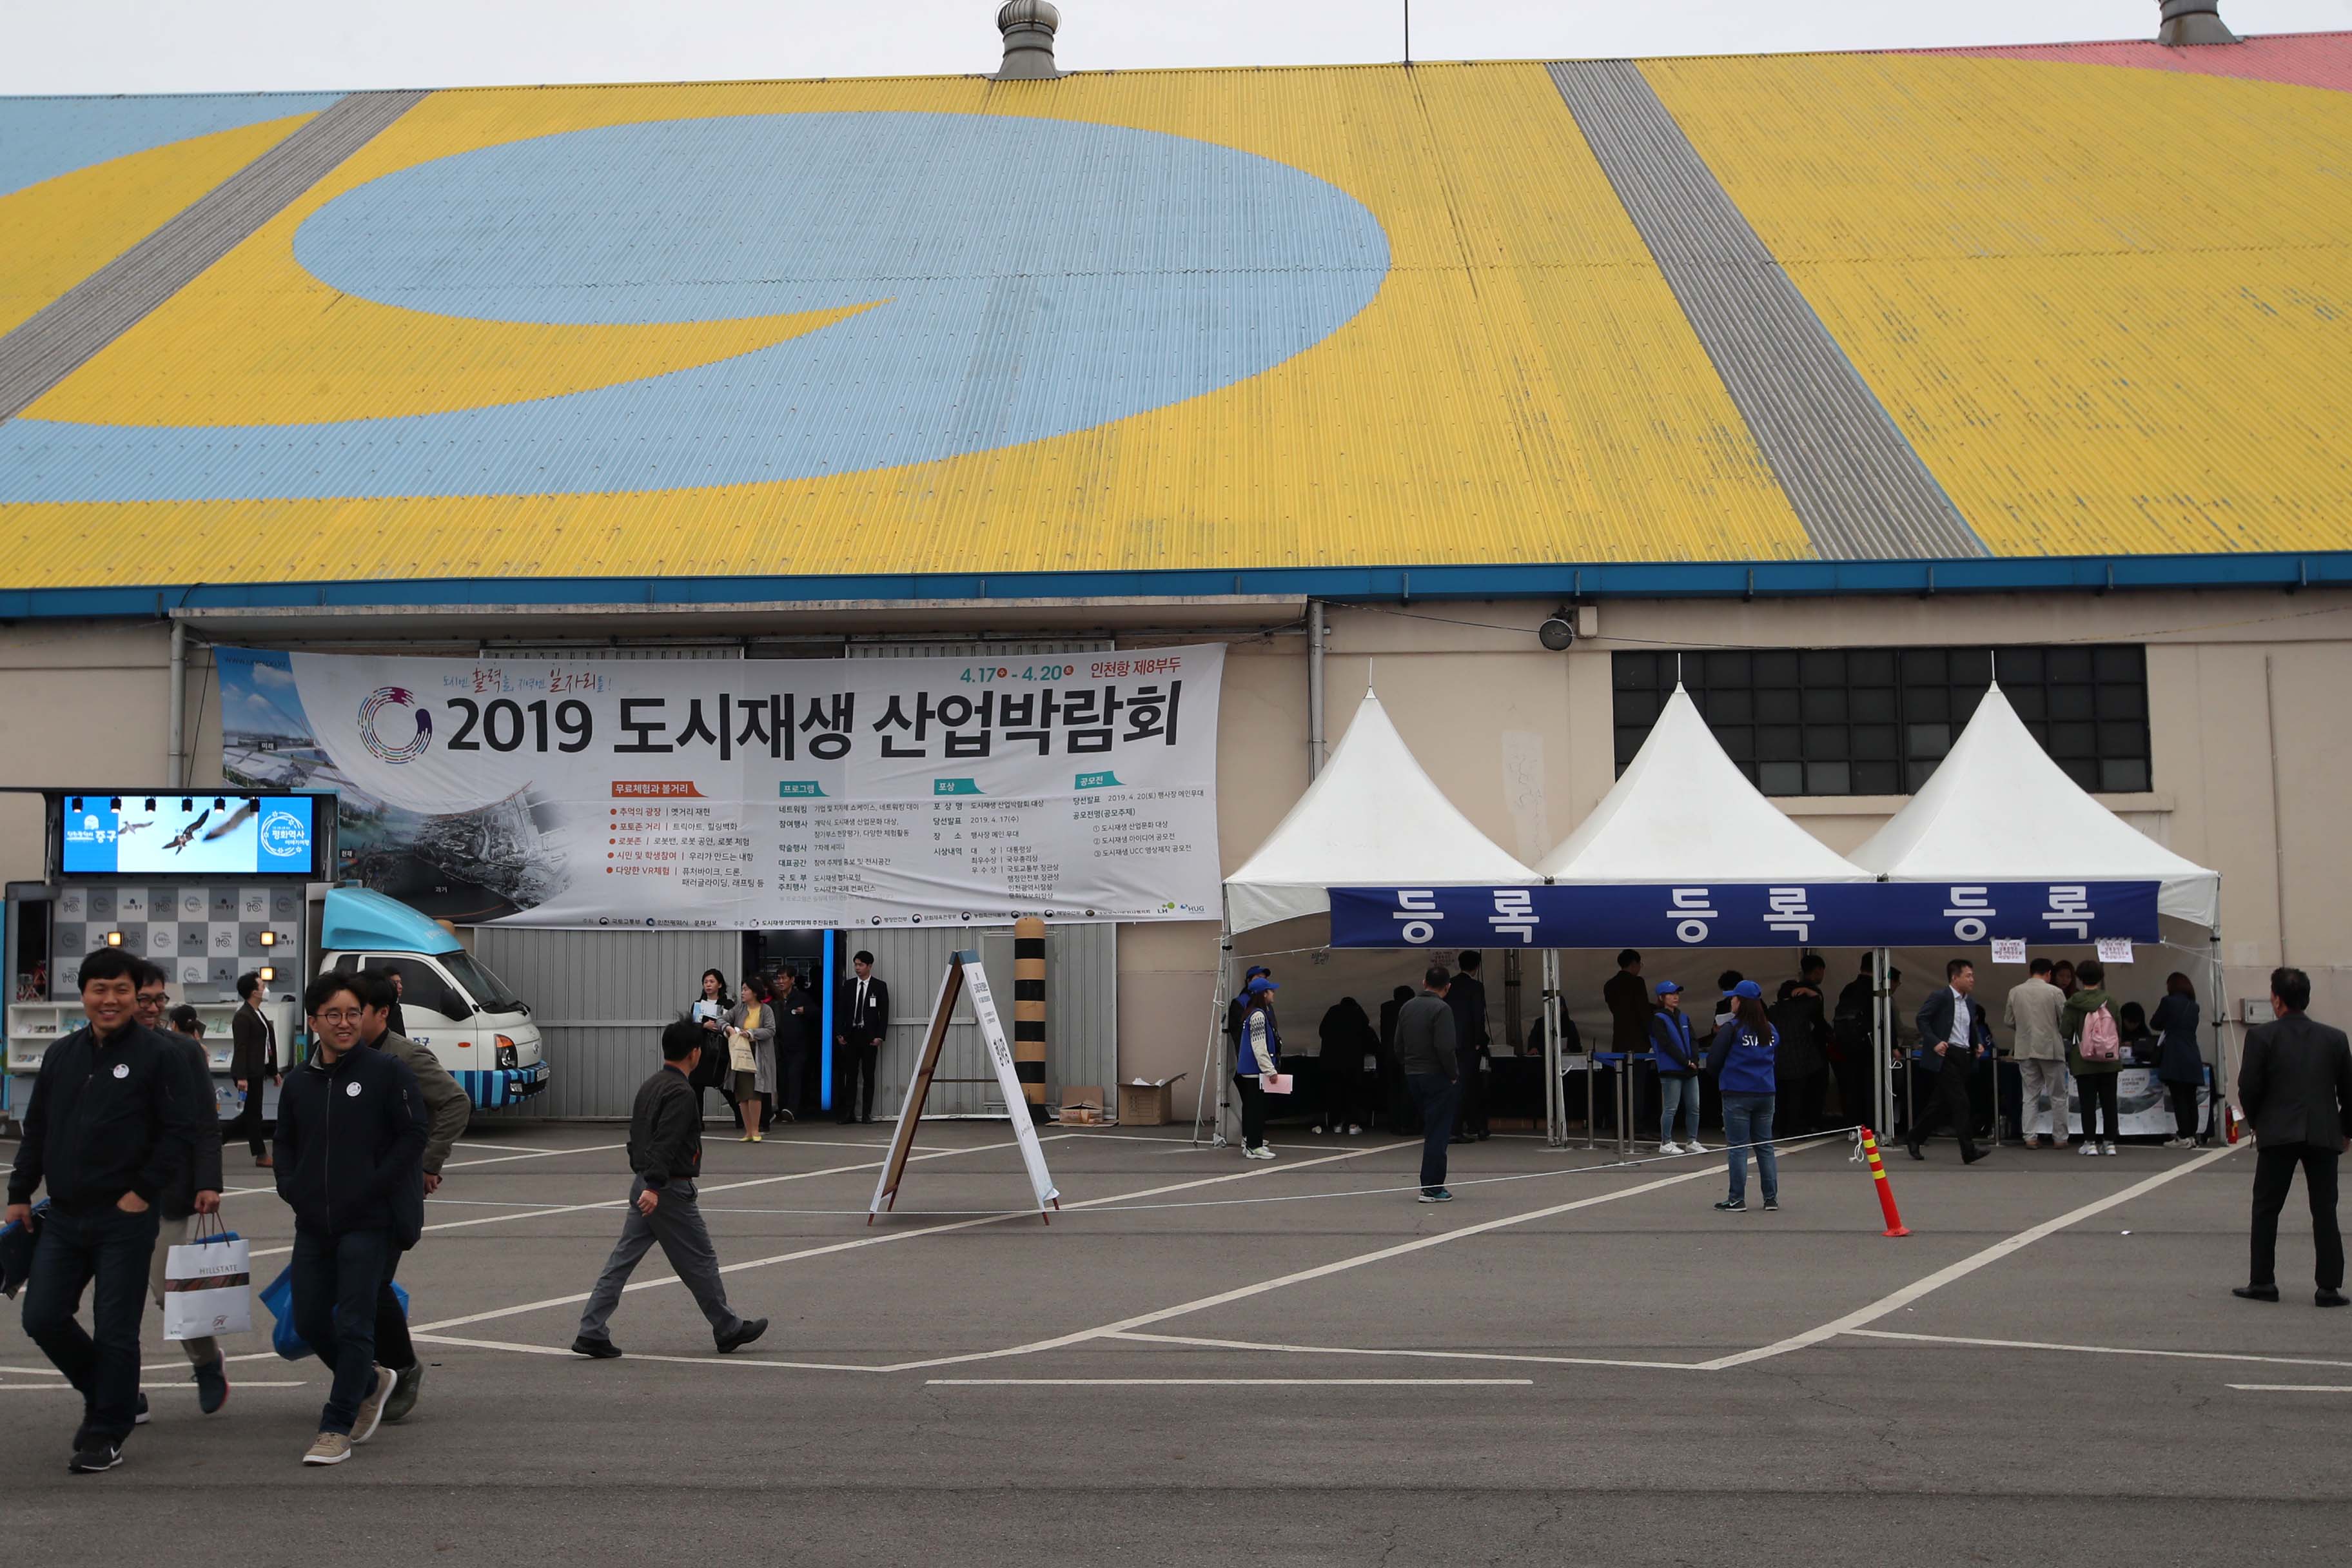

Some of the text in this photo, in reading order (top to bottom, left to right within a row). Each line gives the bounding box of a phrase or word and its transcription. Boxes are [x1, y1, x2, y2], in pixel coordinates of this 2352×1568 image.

[1090, 656, 1182, 679] 인천항 제8부두
[444, 676, 469, 687] 도시엔
[447, 680, 1182, 761] 2019 도시재생 산업박람회
[1080, 775, 1104, 787] 공모전
[615, 783, 689, 794] 무료체험과 볼거리
[783, 784, 815, 794] 프로그램
[938, 782, 955, 791] 포상
[1073, 796, 1101, 806] 당선발표
[1157, 790, 1177, 799] 행사장
[1178, 789, 1204, 798] 메인무대
[814, 805, 827, 813] 기업
[850, 803, 877, 812] 쇼케이스,
[970, 801, 996, 810] 도시재생
[997, 800, 1030, 808] 산업박람회
[620, 807, 710, 817] 추억의 광장 옛거리 재현
[1072, 808, 1136, 819] 공모전명(공모주제)
[779, 820, 808, 828] 참여행사
[857, 818, 882, 826] 산업문화
[884, 818, 899, 826] 대상,
[933, 817, 962, 825] 당선발표
[619, 823, 738, 832] 포토존 거리 트릭아트, 힐링벽화
[1101, 823, 1127, 832] 도시재생
[1129, 822, 1154, 830] 산업문화
[95, 830, 117, 843] 중구
[272, 830, 304, 839] 평화역사
[618, 838, 642, 846] 로봇존
[680, 838, 696, 846] 로봇
[698, 837, 716, 847] 공연,
[718, 838, 733, 846] 로봇
[735, 838, 750, 847] 체험
[1102, 836, 1128, 845] 도시재생
[779, 844, 807, 852] 학술행사
[934, 847, 963, 856] 시상내역
[1006, 845, 1032, 854] 대통령상
[1102, 848, 1128, 857] 도시재생
[1145, 846, 1171, 854] 영상제작
[617, 851, 632, 861] 시민
[634, 851, 642, 860] 및
[645, 851, 677, 861] 학생참여
[689, 852, 712, 861] 우리가
[739, 853, 754, 862] 내항
[971, 856, 996, 865] 최우수상
[778, 859, 807, 868] 대표공간
[865, 858, 891, 866] 전시공간
[615, 867, 743, 877] 다양한 VR체험 퓨처바이크, 드론,
[1007, 873, 1059, 883] 행정안전부 장관상
[681, 879, 765, 888] 패러글라이딩, 래프팅 등
[851, 884, 876, 892] 컨퍼런스
[1008, 883, 1052, 892] 인천광역시장상
[199, 1264, 238, 1275] HILLSTATE
